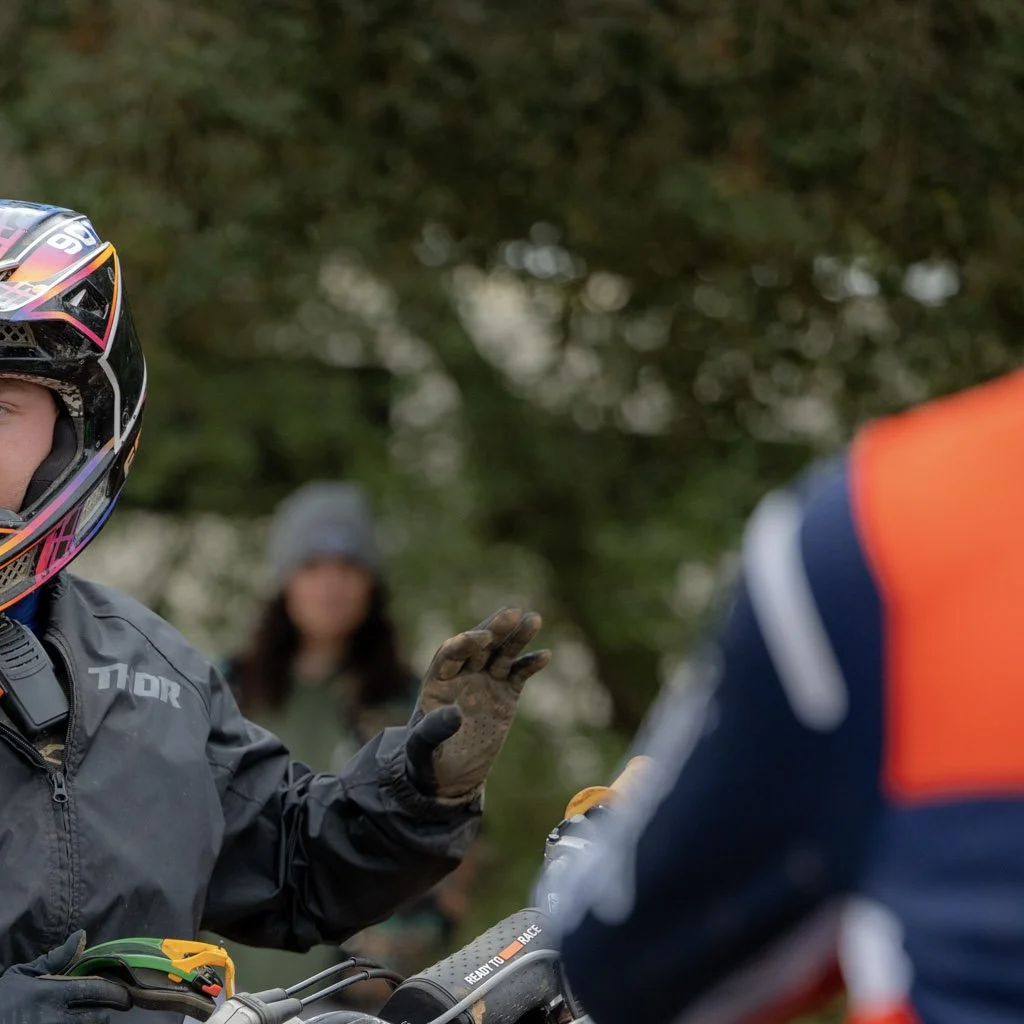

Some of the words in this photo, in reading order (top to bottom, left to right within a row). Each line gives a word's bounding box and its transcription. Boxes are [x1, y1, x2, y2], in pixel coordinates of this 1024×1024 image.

[463, 962, 494, 985] READY
[488, 955, 505, 968] TO
[517, 924, 542, 945] RACE
